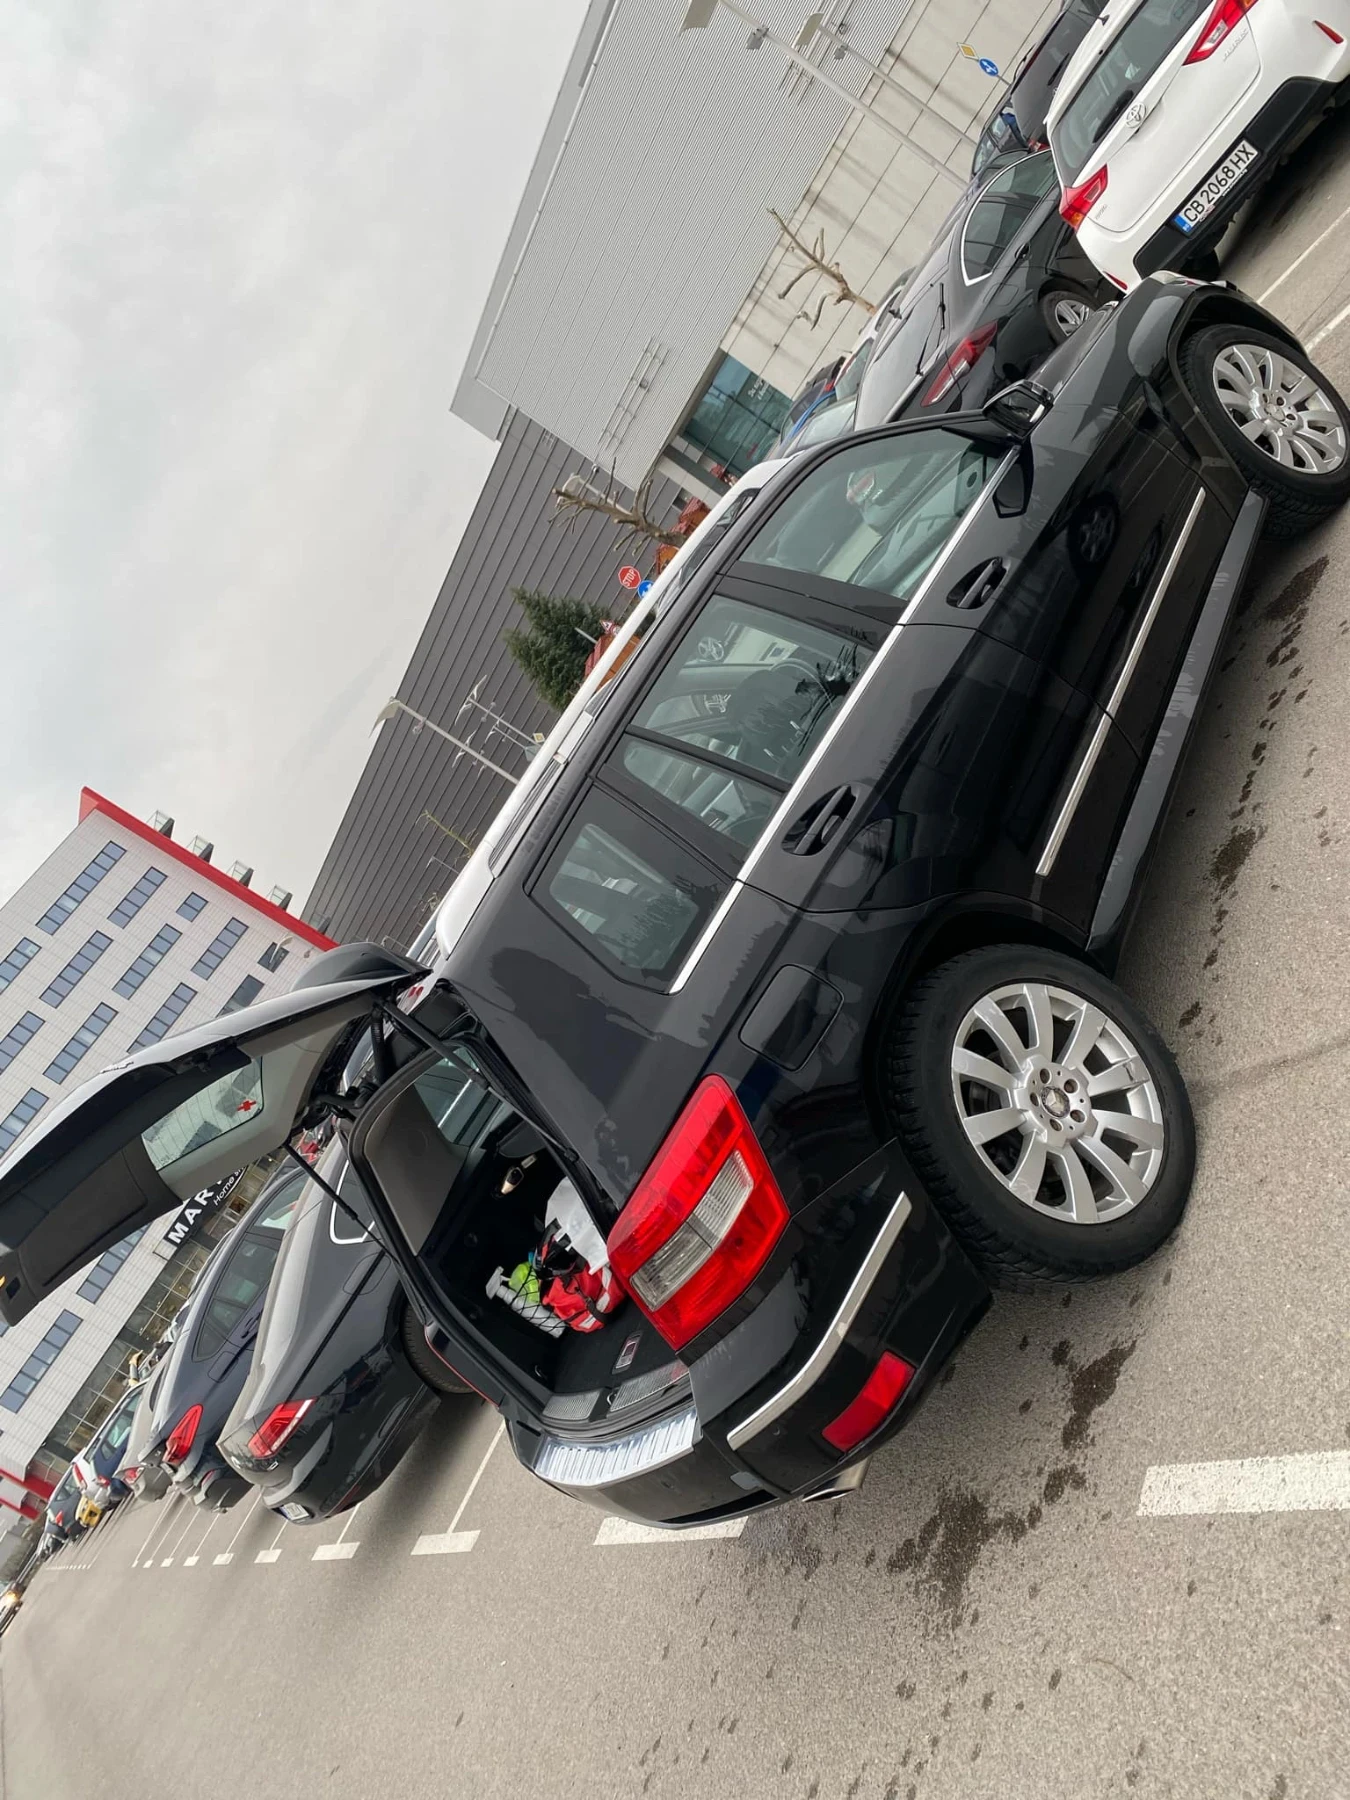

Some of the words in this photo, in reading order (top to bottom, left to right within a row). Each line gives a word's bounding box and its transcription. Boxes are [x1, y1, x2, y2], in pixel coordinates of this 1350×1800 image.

[1183, 200, 1205, 222] CB
[1200, 165, 1235, 204] 2068
[1230, 144, 1254, 170] HX
[622, 568, 636, 587] STOP
[167, 1180, 222, 1244] MAR
[213, 1176, 235, 1206] Home
